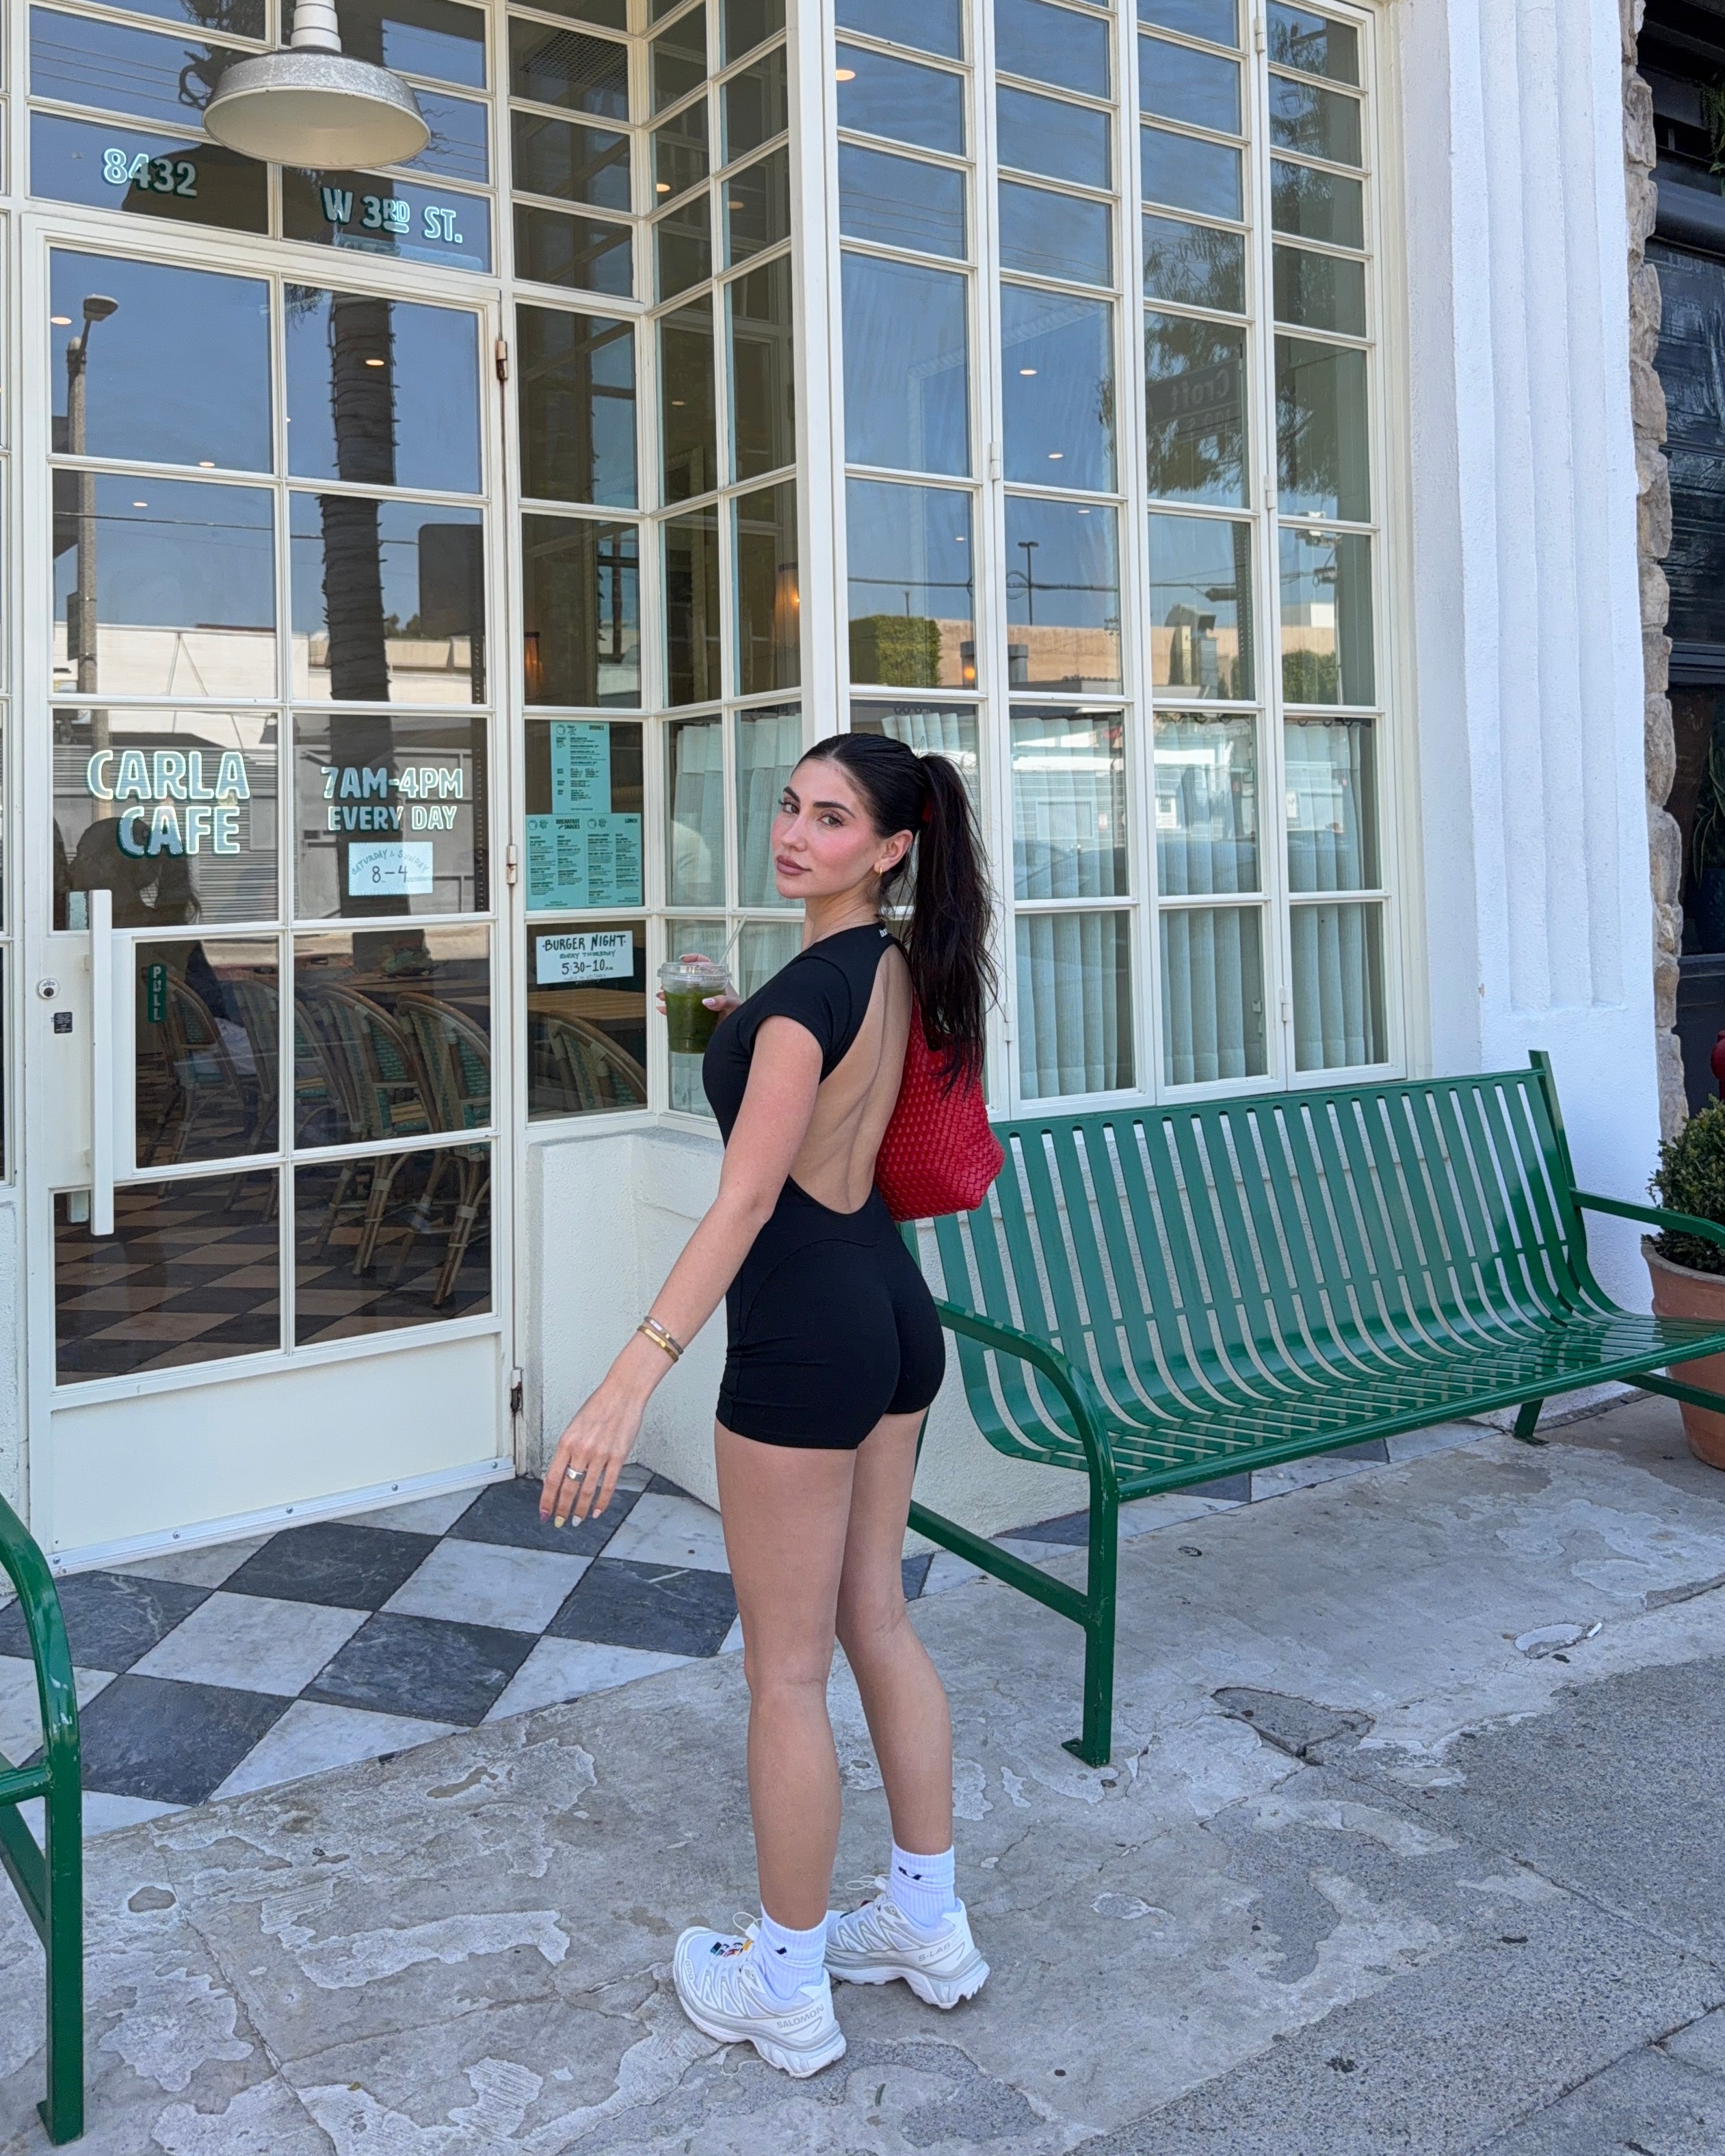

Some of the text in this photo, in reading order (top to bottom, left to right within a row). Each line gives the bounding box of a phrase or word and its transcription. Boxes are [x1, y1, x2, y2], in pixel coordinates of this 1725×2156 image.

[103, 148, 198, 199] 8432
[321, 187, 463, 243] W 3RD ST.
[86, 750, 251, 800] CARLA
[321, 766, 464, 799] 7AM-4PM
[117, 805, 241, 856] CAFE
[328, 806, 458, 831] EVERY DAY
[352, 849, 388, 875] SATURDAY
[397, 849, 430, 873] SUNDAY
[544, 934, 626, 951] BURGER NIGHT
[153, 966, 161, 1020] PULL
[776, 2004, 825, 2029] SALOMON
